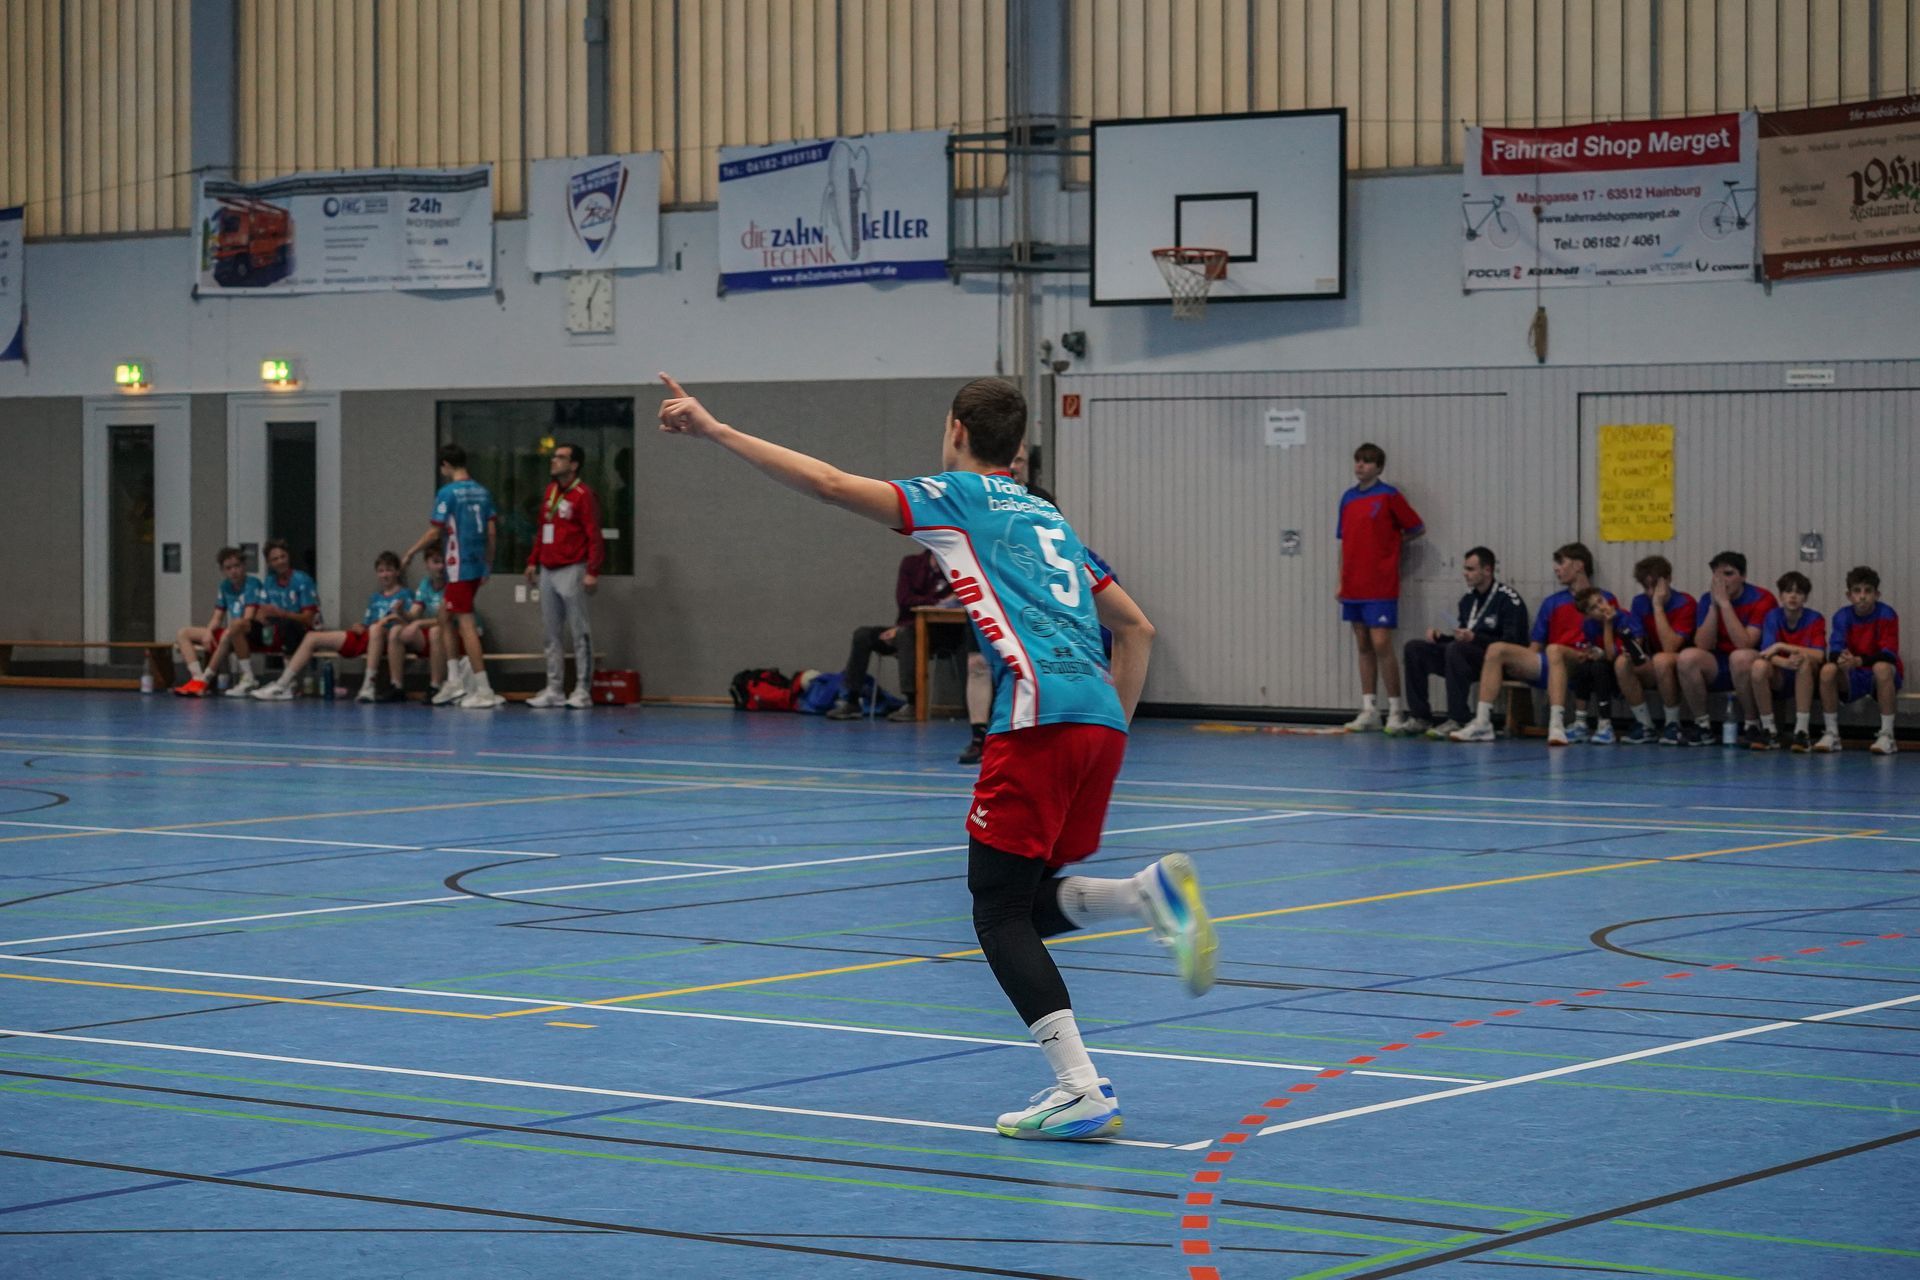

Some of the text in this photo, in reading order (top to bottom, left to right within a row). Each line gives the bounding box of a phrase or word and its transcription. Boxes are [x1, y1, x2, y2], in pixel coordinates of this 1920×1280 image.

[1491, 128, 1732, 161] Fahrrad Shop Merget
[1516, 191, 1579, 204] Maingasse
[1583, 190, 1595, 201] 17
[1607, 188, 1642, 200] 63512
[1646, 186, 1701, 200] Hainburg
[408, 197, 442, 213] 24h
[1583, 236, 1619, 248] 06182
[1632, 234, 1661, 247] 4061
[1468, 268, 1511, 278] FOCUS
[1033, 525, 1081, 608] 5
